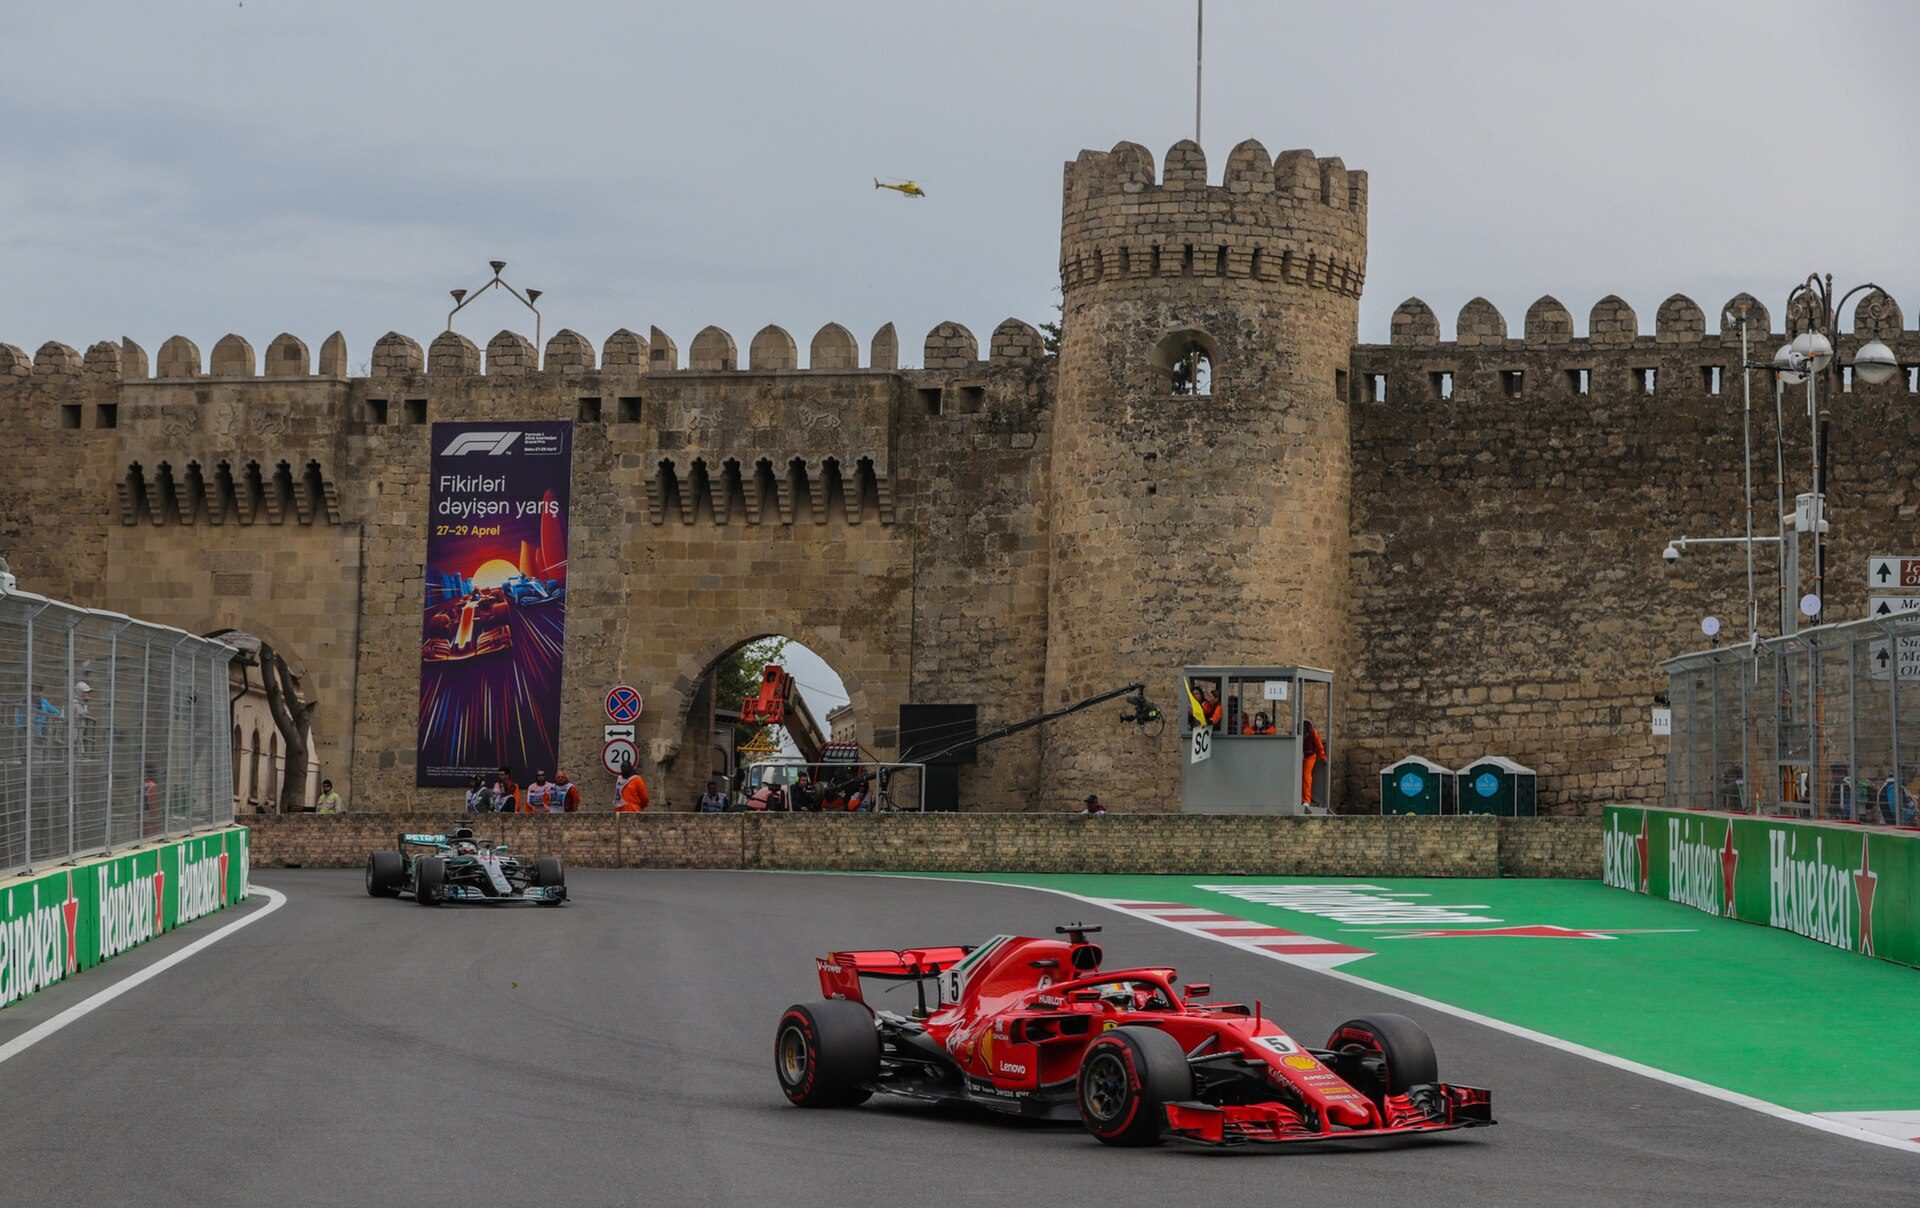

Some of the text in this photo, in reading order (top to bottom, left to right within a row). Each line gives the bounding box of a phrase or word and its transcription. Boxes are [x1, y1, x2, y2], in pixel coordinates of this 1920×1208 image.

[440, 474, 506, 492] Fikirləri
[438, 496, 559, 519] dəyişən yarış
[471, 524, 500, 538] Aprel
[1194, 730, 1209, 755] SC
[611, 749, 631, 763] 20
[1668, 818, 1720, 916] Heineken
[177, 840, 219, 924] Heineken
[1769, 829, 1852, 951] Heineken
[98, 858, 153, 958] Heineken
[0, 884, 63, 1008] eineken
[951, 972, 960, 1002] 5
[1039, 994, 1064, 1006] HUBLOT
[1264, 1037, 1291, 1053] 5
[1000, 1060, 1026, 1075] Lenovo
